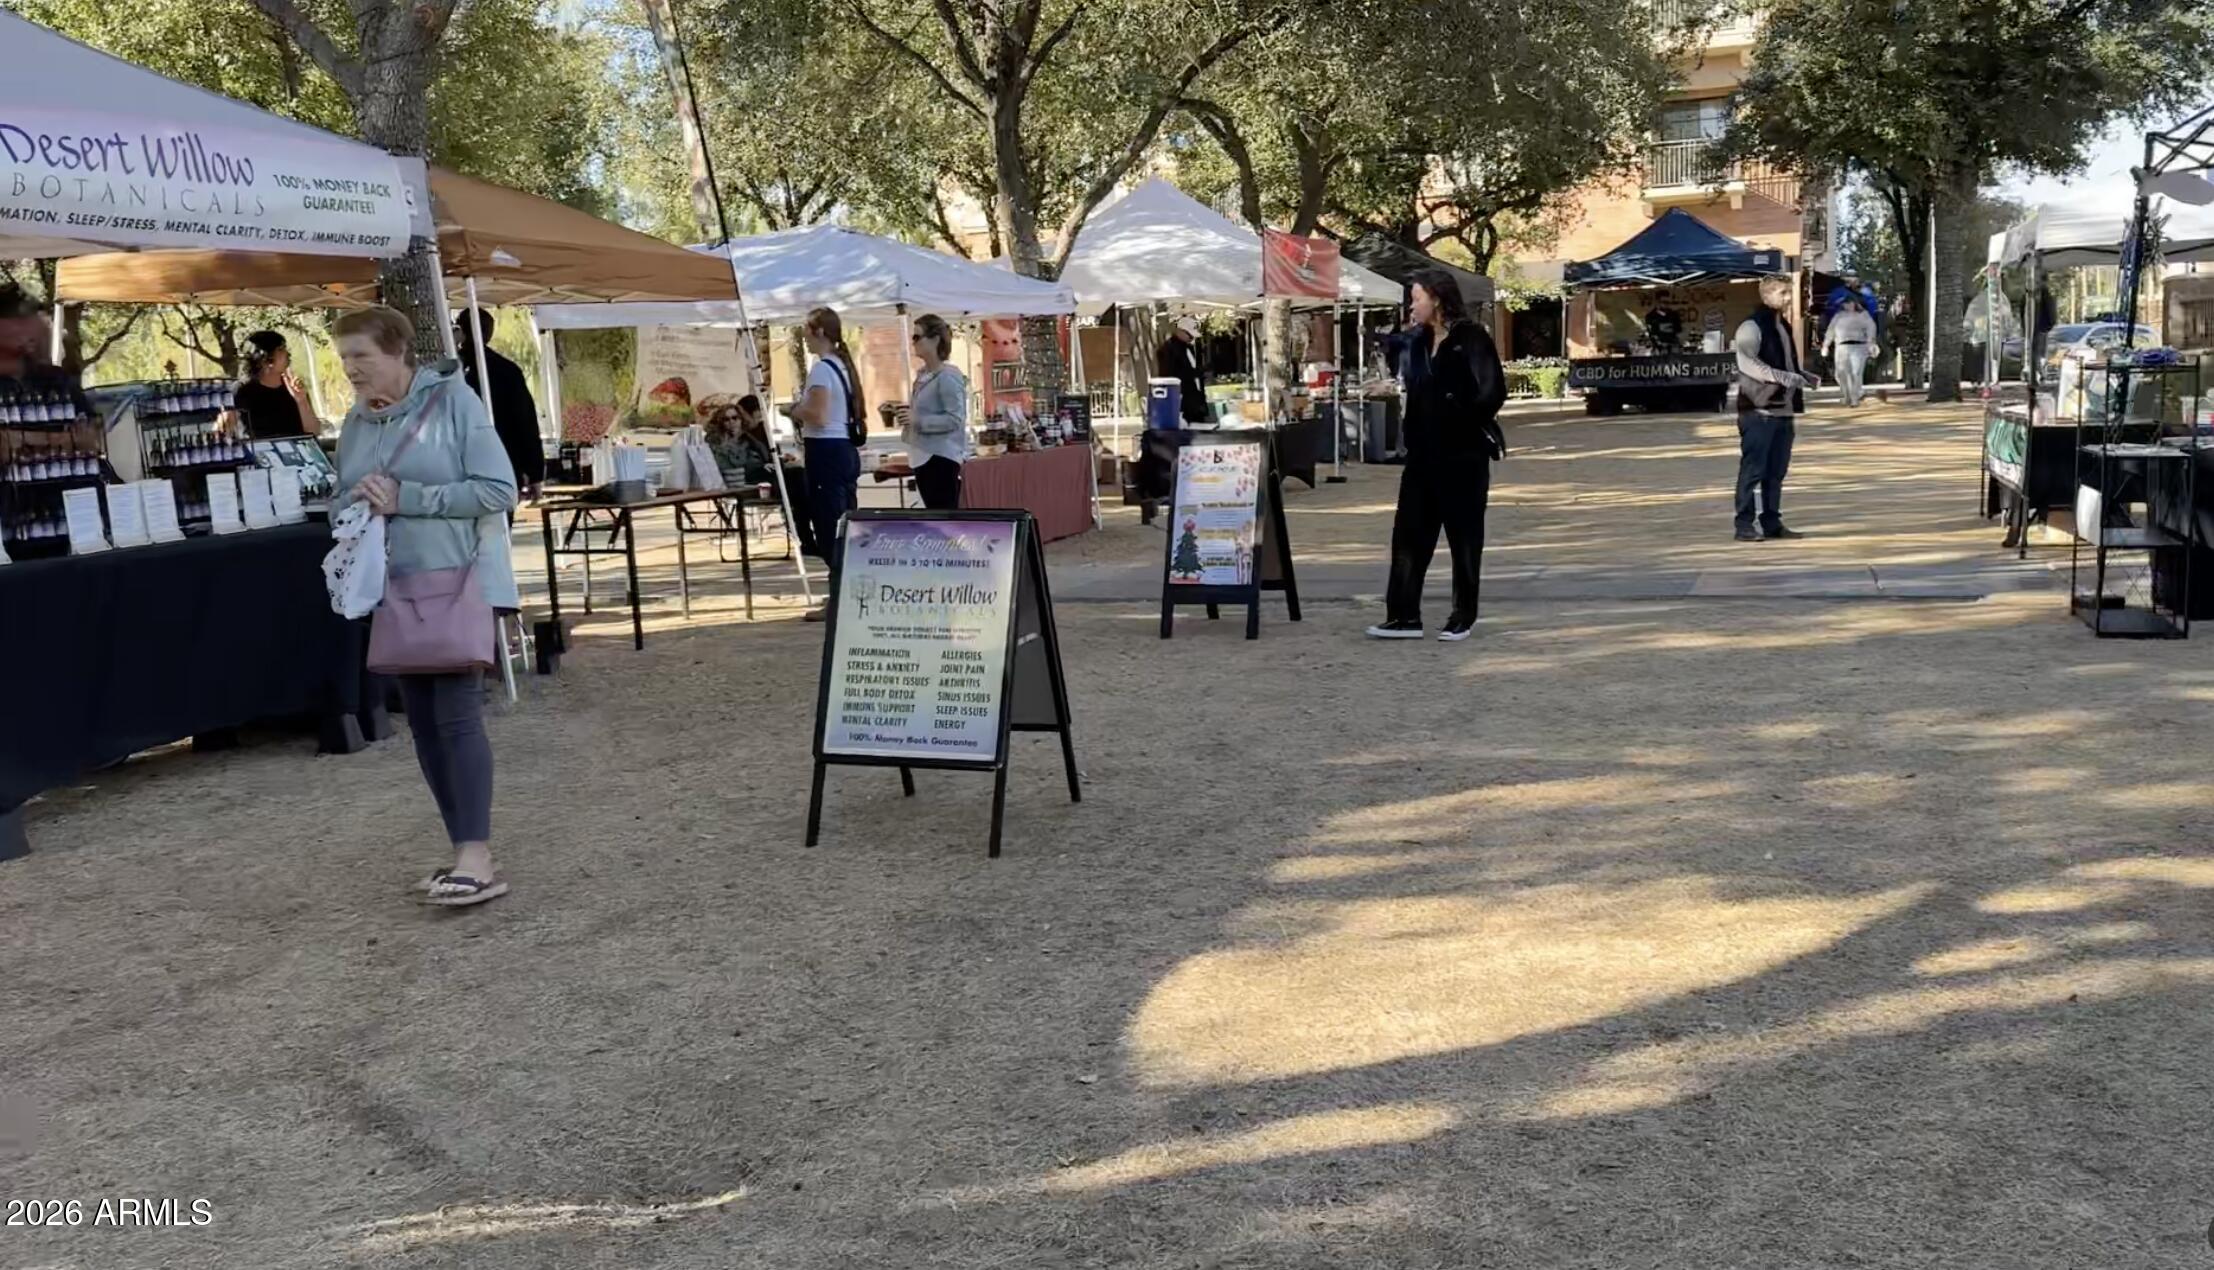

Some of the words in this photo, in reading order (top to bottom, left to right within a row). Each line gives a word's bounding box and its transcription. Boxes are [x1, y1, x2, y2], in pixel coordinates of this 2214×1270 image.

[0, 123, 135, 176] Desert
[141, 131, 255, 187] Willow
[273, 174, 311, 191] 100%
[313, 178, 360, 195] MONEY
[363, 182, 391, 198] BACK
[12, 171, 265, 217] BOTANICALS
[66, 212, 160, 231] SLEEP/STRESS,
[164, 220, 211, 235] MENTAL
[215, 224, 264, 240] CLARITY,
[269, 227, 308, 241] DETOX,
[311, 231, 354, 245] IMMUNE
[357, 233, 391, 247] BOOST
[1575, 366, 1606, 380] CBD
[1608, 365, 1627, 379] for
[1630, 363, 1691, 378] HUMANS
[1693, 363, 1719, 376] and
[872, 532, 906, 550] Free
[880, 584, 935, 604] Desert
[941, 583, 998, 605] Willow
[941, 650, 983, 661] ALLERGIES
[847, 661, 875, 671] STRESS
[886, 662, 920, 673] ANXIETY
[939, 664, 963, 674] JOINT
[965, 664, 986, 675] PAIN
[902, 676, 930, 688] ISSUES
[843, 687, 861, 698] FULL
[863, 688, 886, 699] BODY
[888, 689, 916, 700] DETOX
[937, 691, 961, 702] SINUS
[963, 692, 991, 704] ISSUES
[878, 702, 916, 714] SUPPORT
[936, 705, 958, 716] SLEEP
[960, 706, 988, 718] ISSUES
[874, 716, 908, 727] CLARITY
[934, 719, 966, 730] ENERGY
